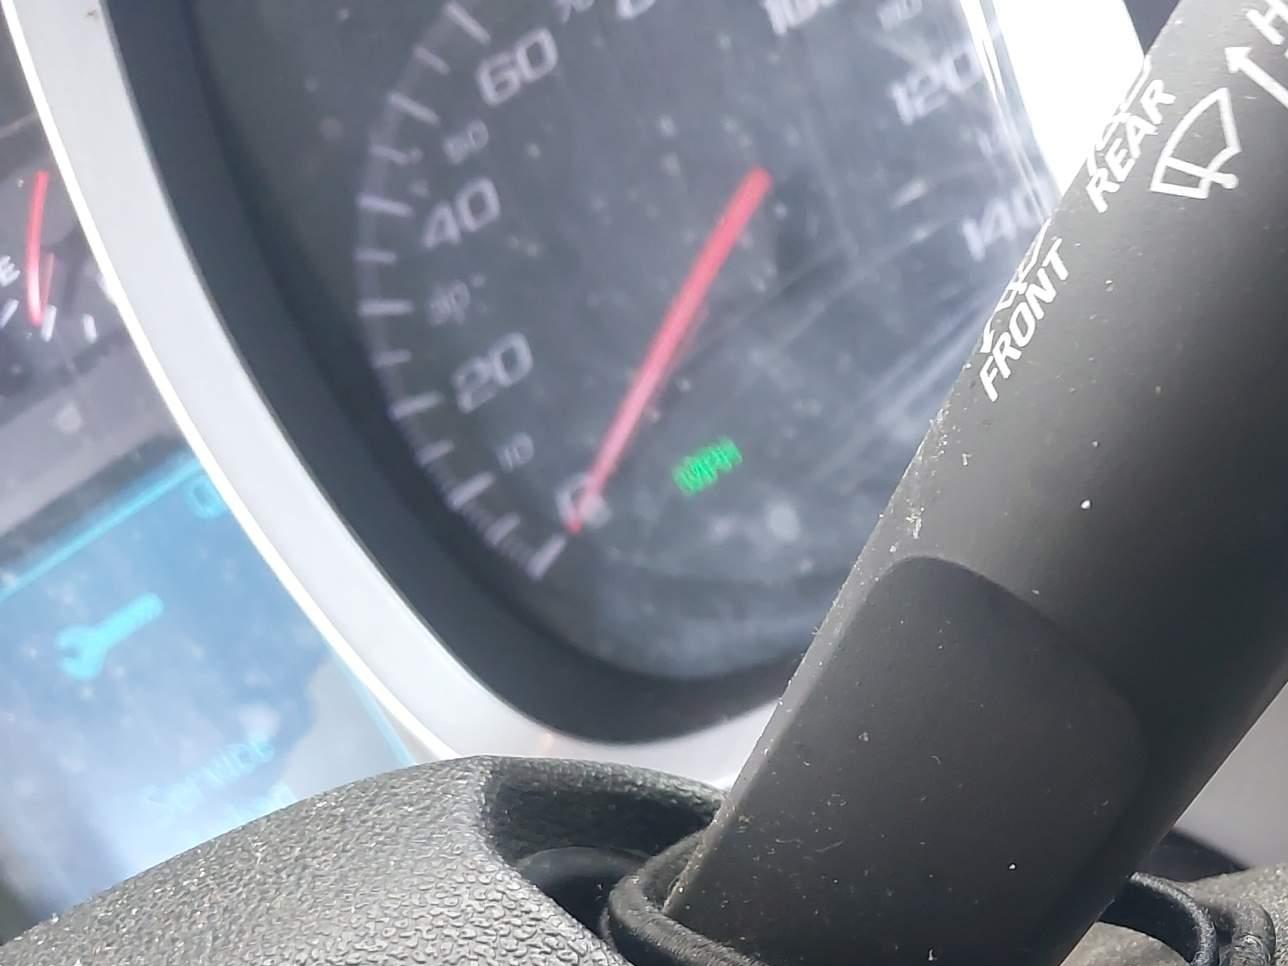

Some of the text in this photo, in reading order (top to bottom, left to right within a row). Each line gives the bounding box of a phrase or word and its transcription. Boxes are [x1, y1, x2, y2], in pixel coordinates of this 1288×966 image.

[478, 27, 559, 106] 60
[1086, 78, 1176, 213] REAR
[421, 175, 502, 252] 40
[978, 238, 1069, 402] FRONT
[450, 331, 535, 414] 20
